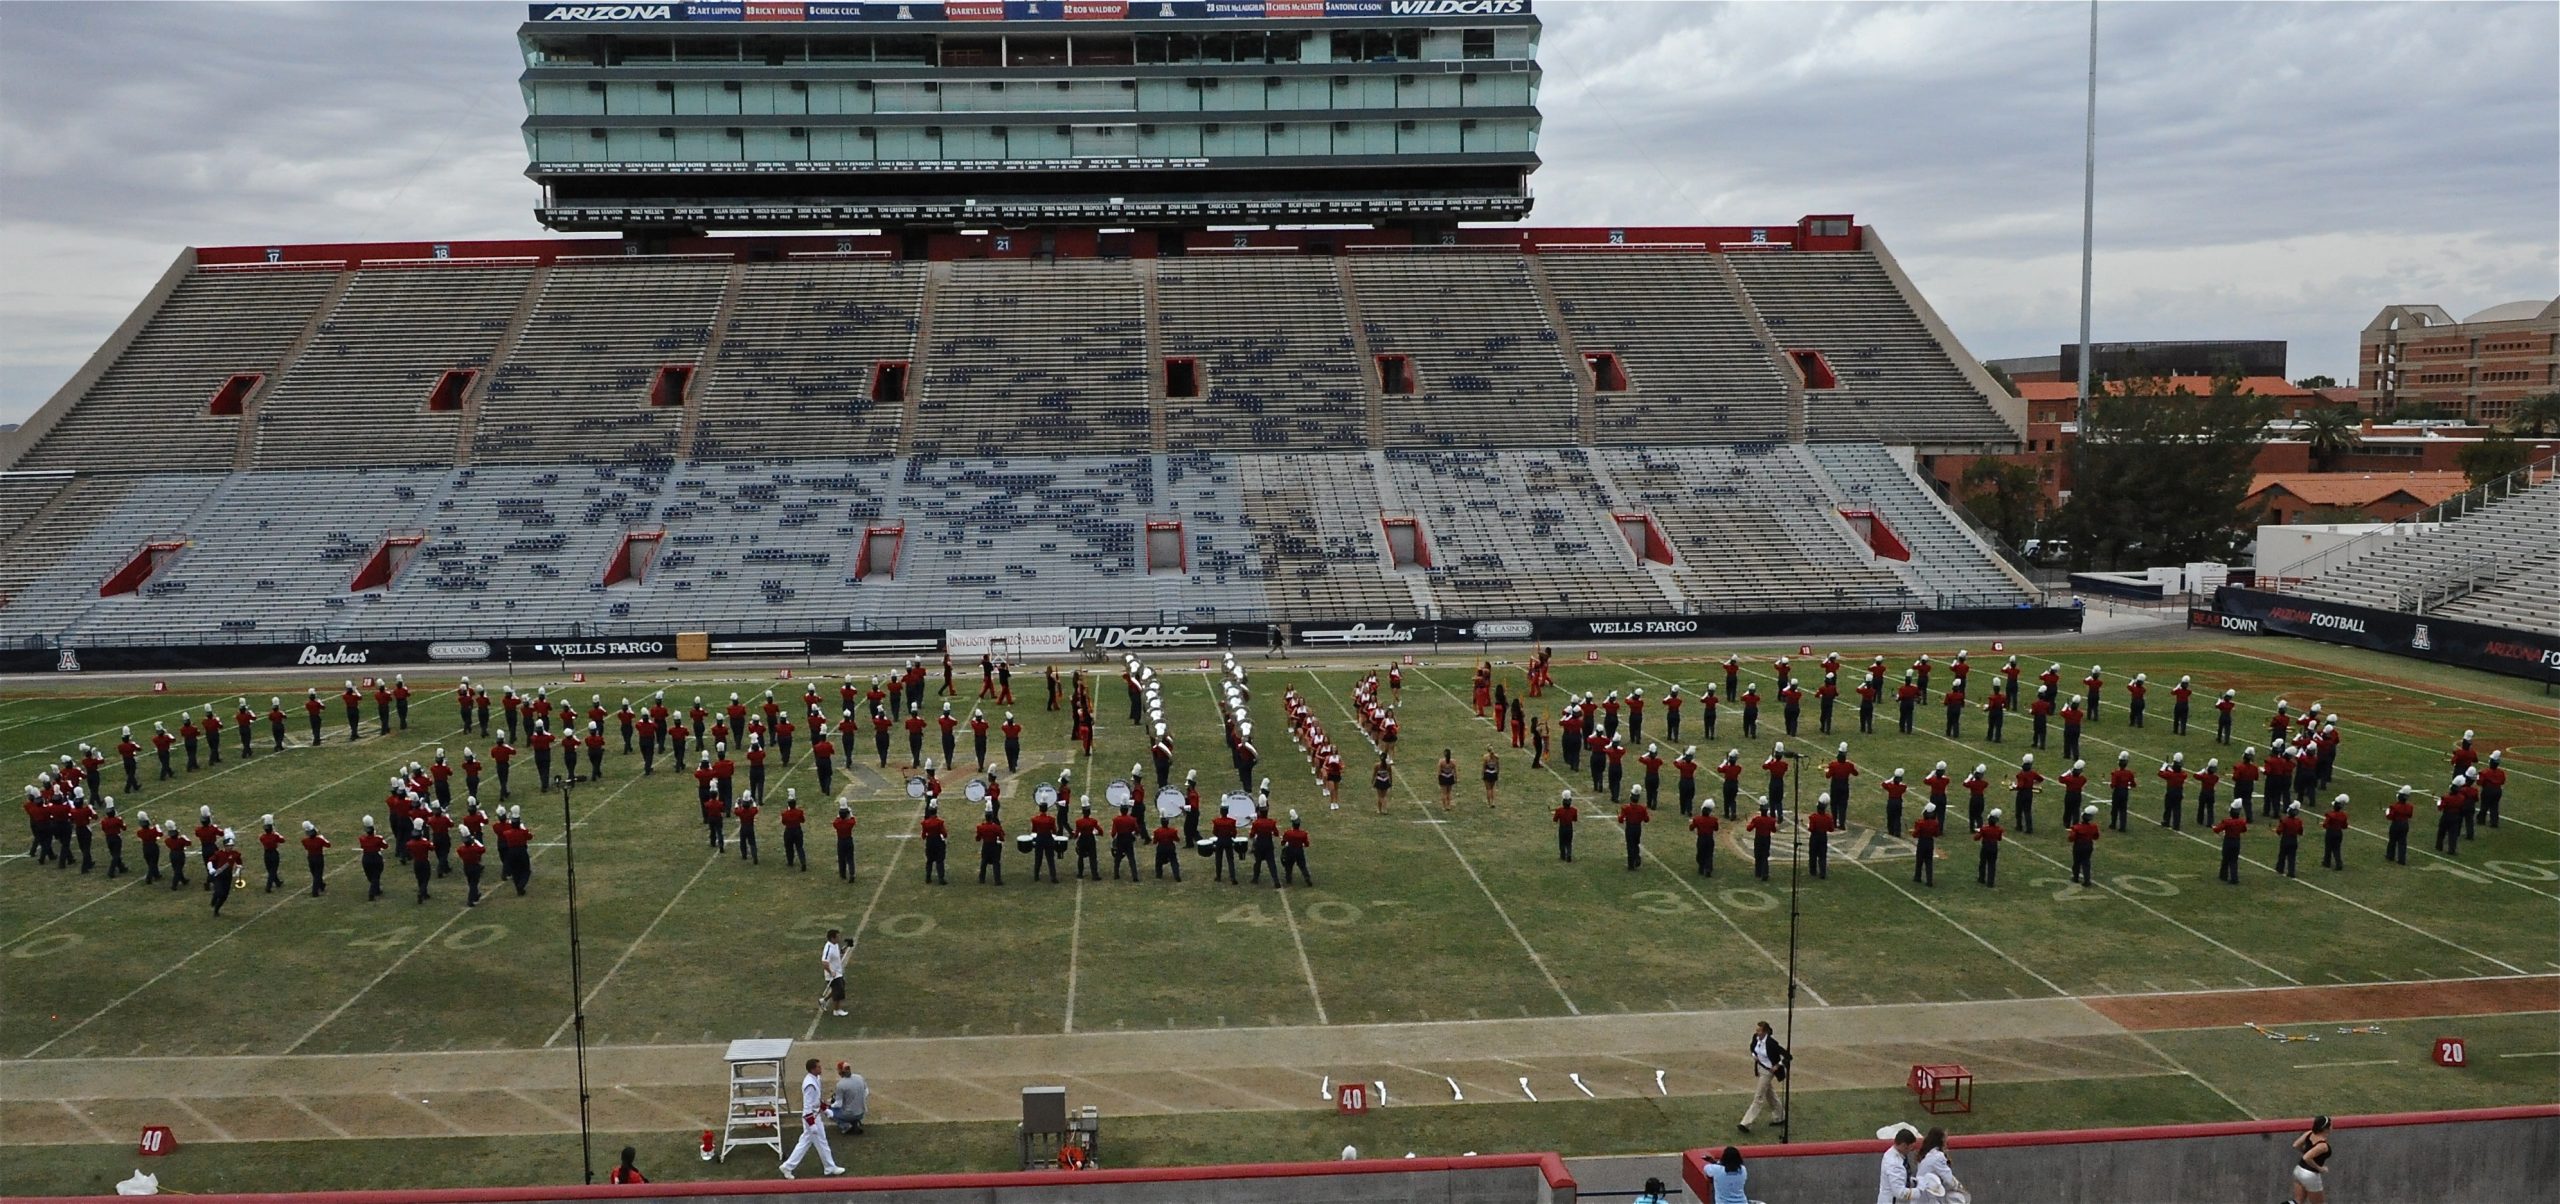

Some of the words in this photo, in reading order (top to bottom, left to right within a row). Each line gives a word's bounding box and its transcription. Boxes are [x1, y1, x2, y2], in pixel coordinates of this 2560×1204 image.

[544, 6, 671, 20] ARIZONA
[687, 6, 696, 15] 22
[697, 6, 710, 15] ART
[711, 6, 741, 15] LUPPINO
[755, 6, 777, 15] RICKY
[778, 6, 803, 15] HUNLEY
[815, 6, 840, 15] CHUCK
[841, 6, 861, 15] CECIL
[946, 6, 951, 15] 4
[983, 6, 1003, 15] LEWIS
[1073, 5, 1087, 14] ROB
[1089, 5, 1121, 14] WALDROP
[1216, 3, 1230, 12] STEVE
[1266, 3, 1271, 12] 11
[1272, 3, 1291, 12] CHRIS
[1325, 3, 1330, 11] 5
[1330, 3, 1358, 11] ANTOINE
[1359, 3, 1382, 11] CASON
[1390, 0, 1524, 14] WILDCATS
[1234, 239, 1247, 248] 22
[1610, 235, 1623, 244] 24
[1753, 234, 1766, 243] 25
[837, 242, 852, 252] 20
[997, 241, 1009, 250] 21
[268, 253, 280, 262] 17
[435, 249, 447, 259] 18
[2221, 615, 2258, 632] DOWN
[2269, 607, 2311, 621] ARIZONA
[2309, 612, 2366, 633] FOOTBALL
[1589, 622, 1643, 633] WELLS
[1645, 621, 1697, 632] FARGO
[950, 637, 987, 647] UNIVERSITY
[1031, 635, 1051, 645] BAND
[1052, 634, 1066, 645] DAY
[549, 643, 606, 655] WELLS
[608, 642, 663, 654] FARGO
[2485, 641, 2541, 662] ARIZONA
[298, 645, 370, 665] Bashas'
[2029, 875, 2180, 901] 20
[1631, 888, 1779, 912] 30
[1216, 901, 1363, 927] 40
[347, 925, 508, 950] 40
[2442, 1043, 2463, 1062] 20
[1342, 1089, 1362, 1109] 40
[141, 1130, 162, 1152] 40
